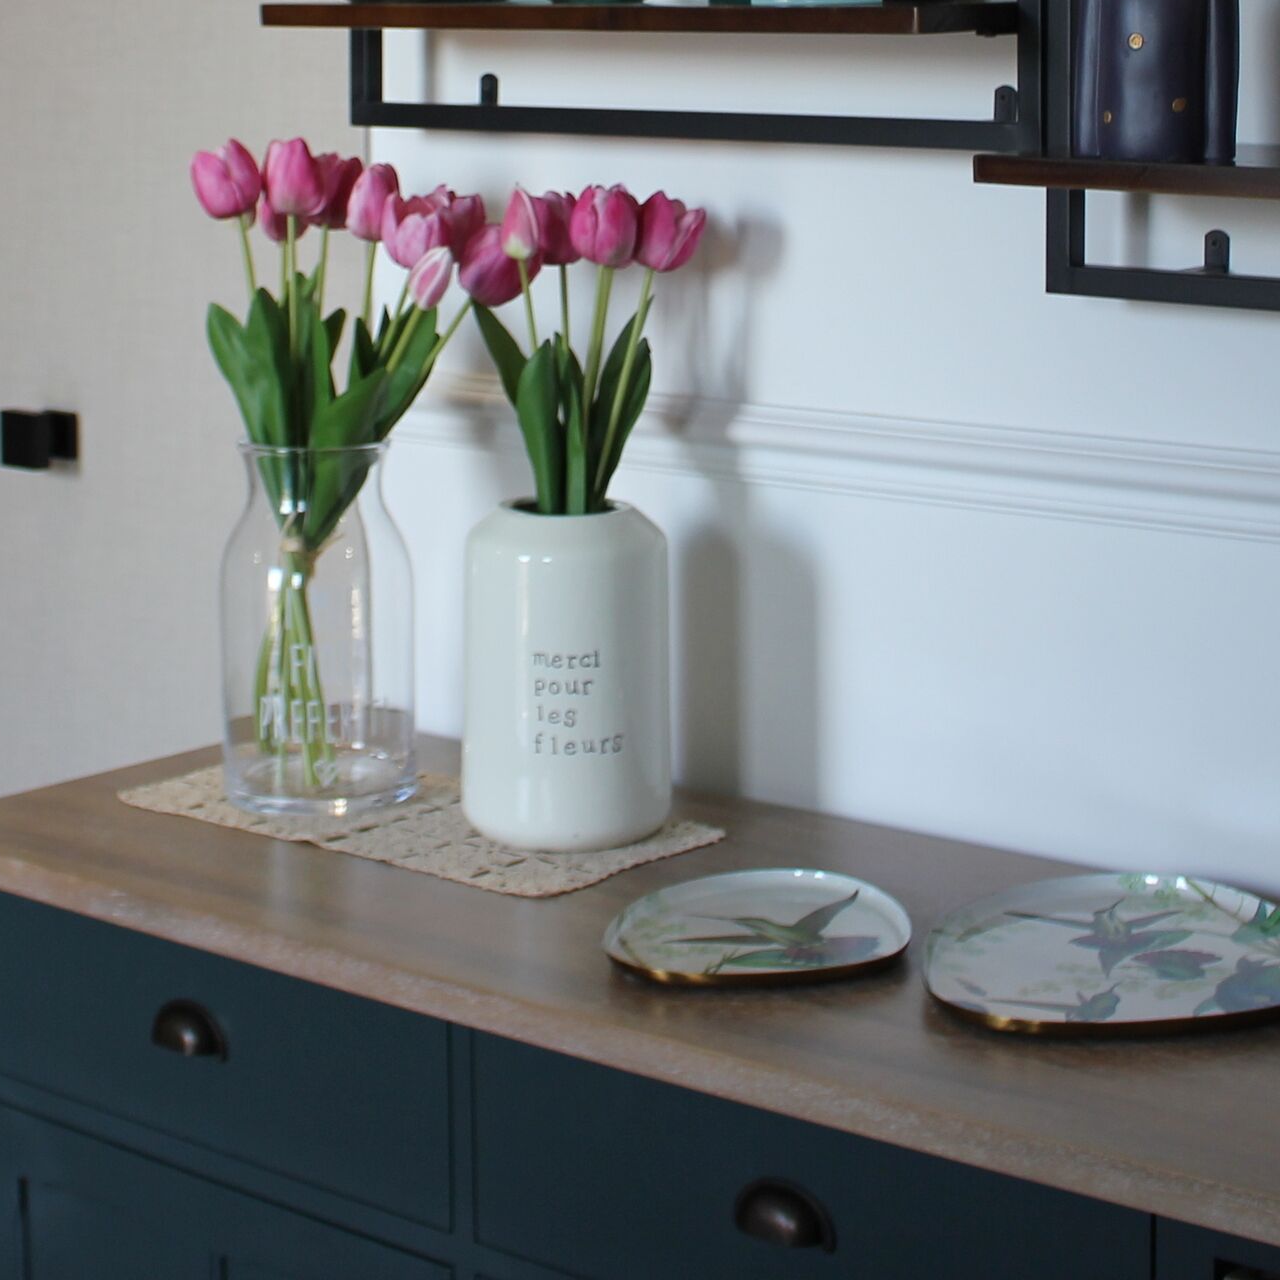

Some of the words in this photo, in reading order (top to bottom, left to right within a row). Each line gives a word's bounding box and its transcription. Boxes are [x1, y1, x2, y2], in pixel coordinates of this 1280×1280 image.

[532, 649, 602, 670] merci
[534, 679, 595, 697] pour
[536, 705, 578, 728] les
[532, 732, 626, 756] fleurs
